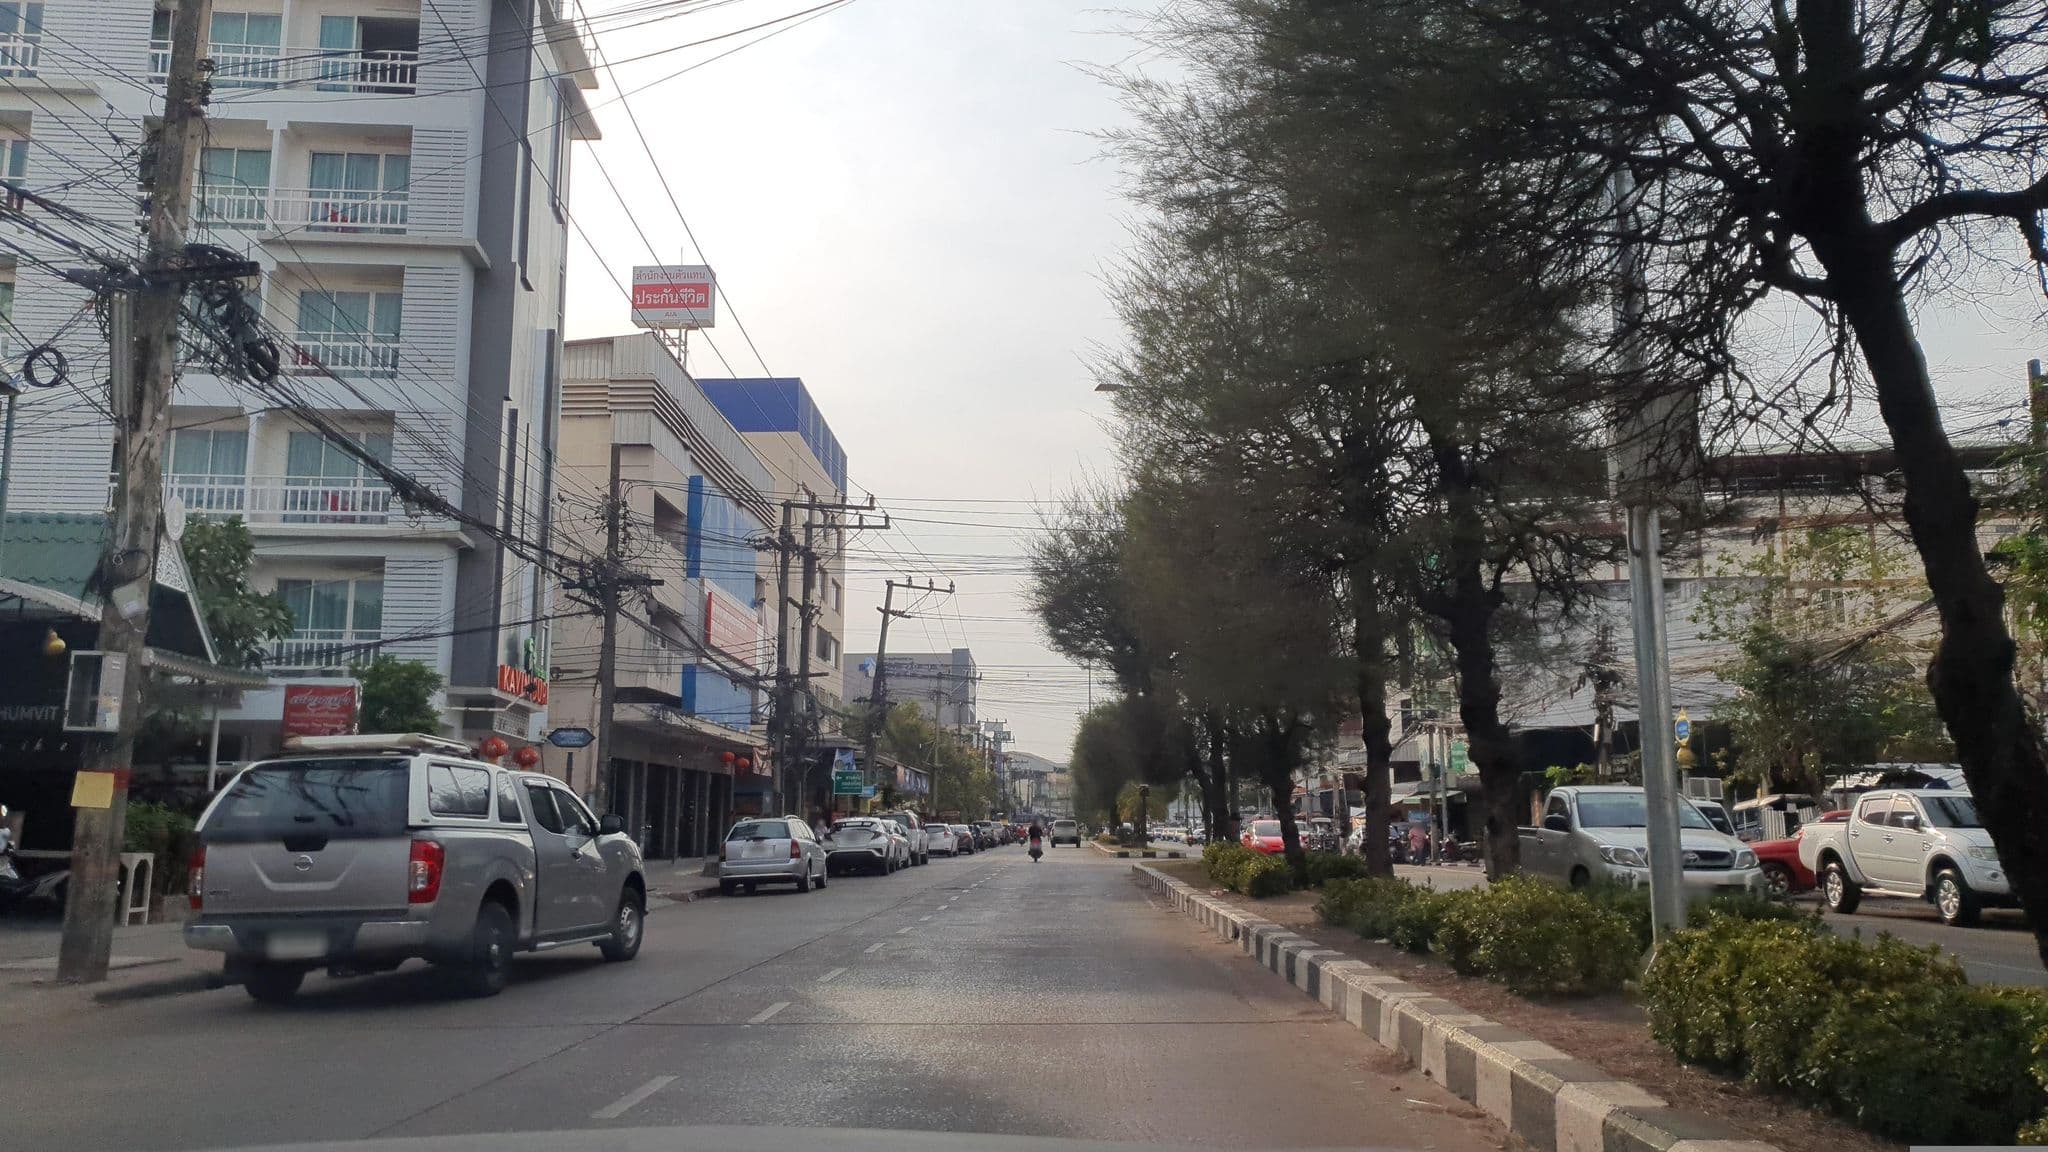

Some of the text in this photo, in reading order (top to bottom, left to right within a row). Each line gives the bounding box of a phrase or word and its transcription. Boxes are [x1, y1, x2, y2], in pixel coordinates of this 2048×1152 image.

[636, 287, 705, 305] ประกันชีวิต
